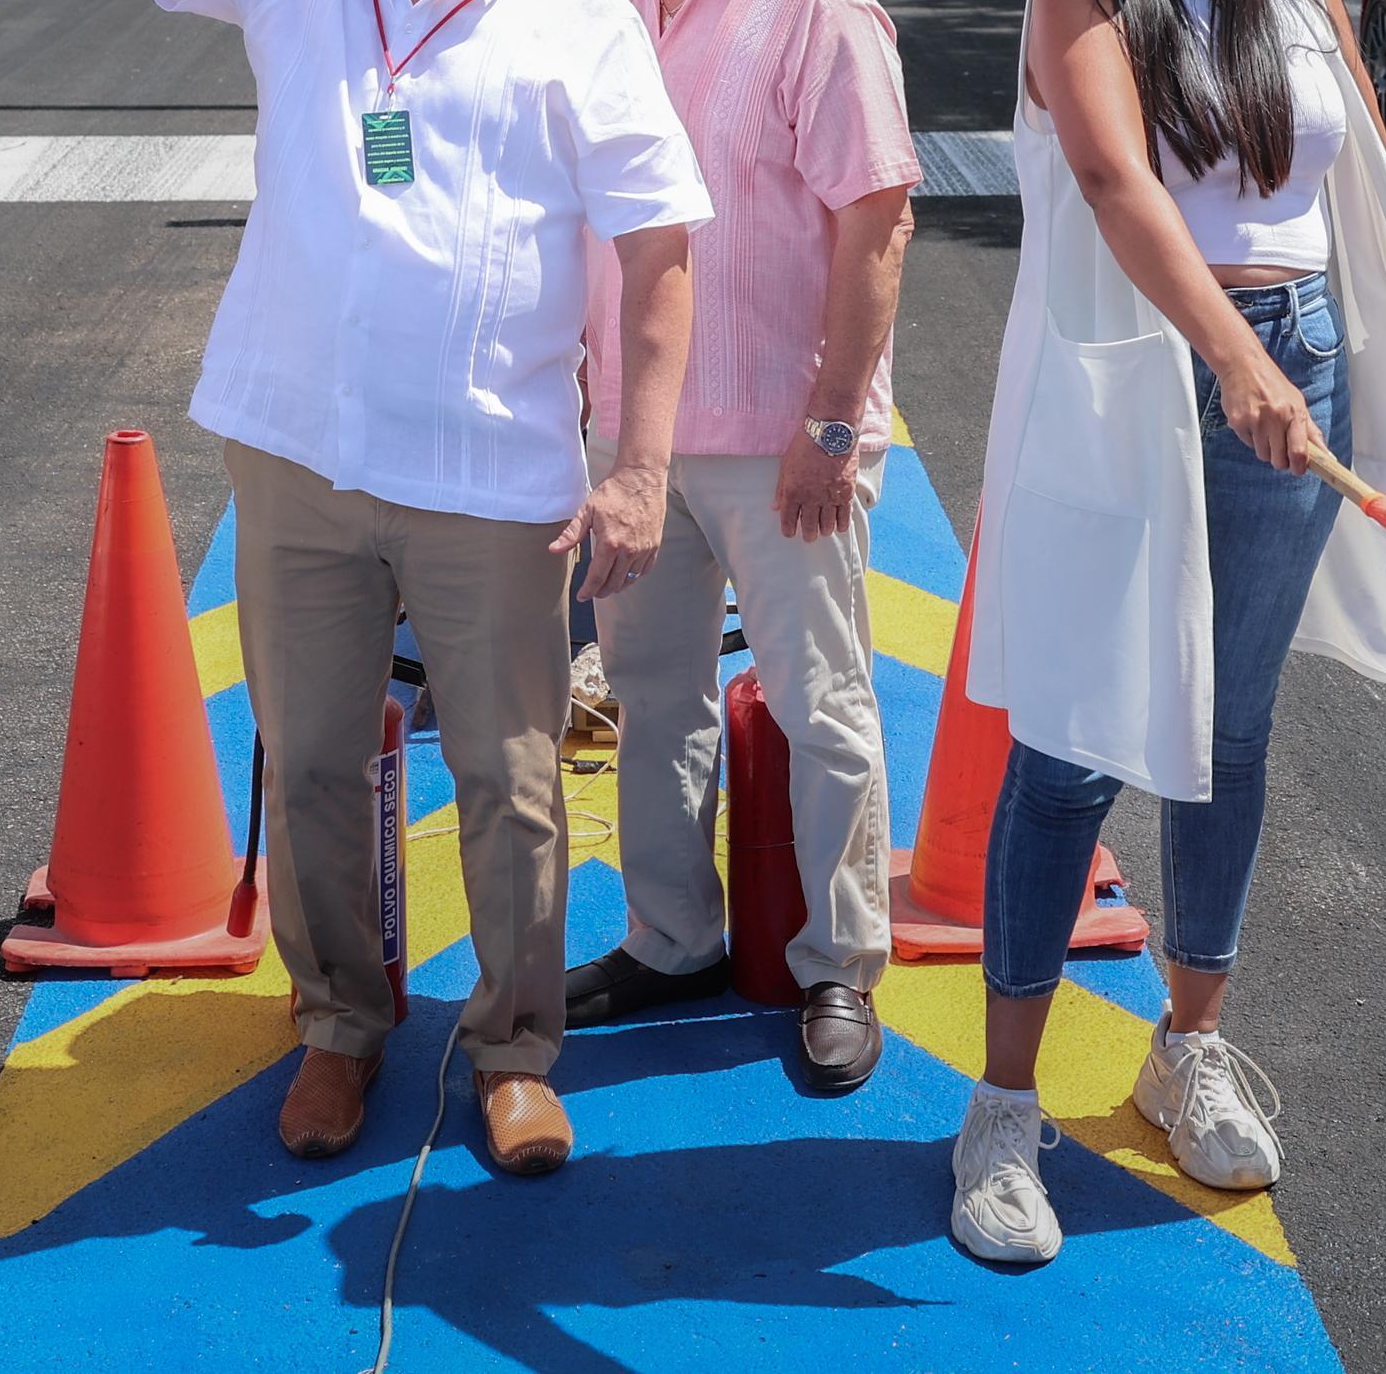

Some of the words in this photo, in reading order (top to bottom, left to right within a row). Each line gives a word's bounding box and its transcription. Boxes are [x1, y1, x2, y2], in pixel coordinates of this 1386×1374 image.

[384, 770, 396, 813] SECO
[384, 815, 396, 885] QUIMICO
[384, 887, 396, 940] POLVO
